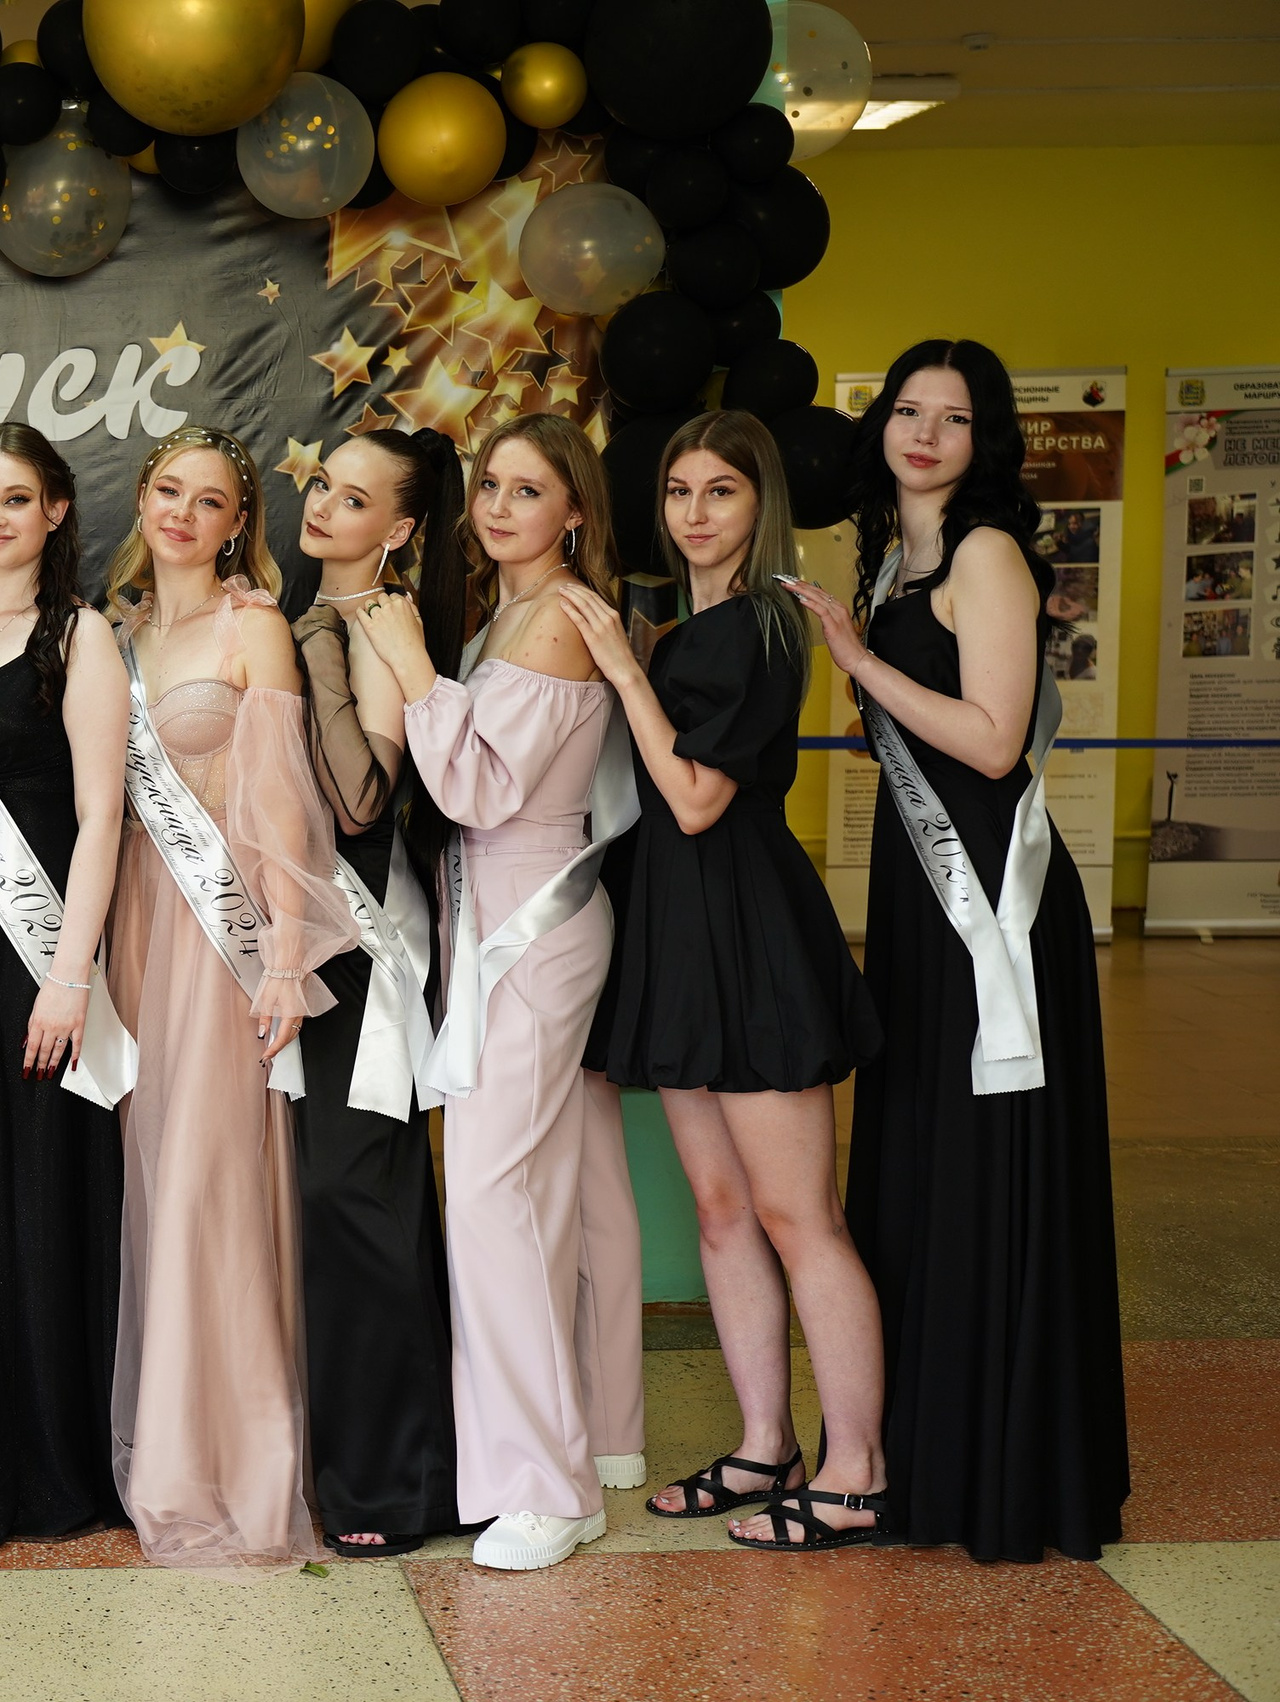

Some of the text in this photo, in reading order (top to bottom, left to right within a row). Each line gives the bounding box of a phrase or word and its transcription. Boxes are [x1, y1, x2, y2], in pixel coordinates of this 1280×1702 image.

[1234, 382, 1280, 390] ОБРАЗОВА
[1028, 436, 1105, 450] ЕРСТВА
[193, 867, 260, 957] 2024
